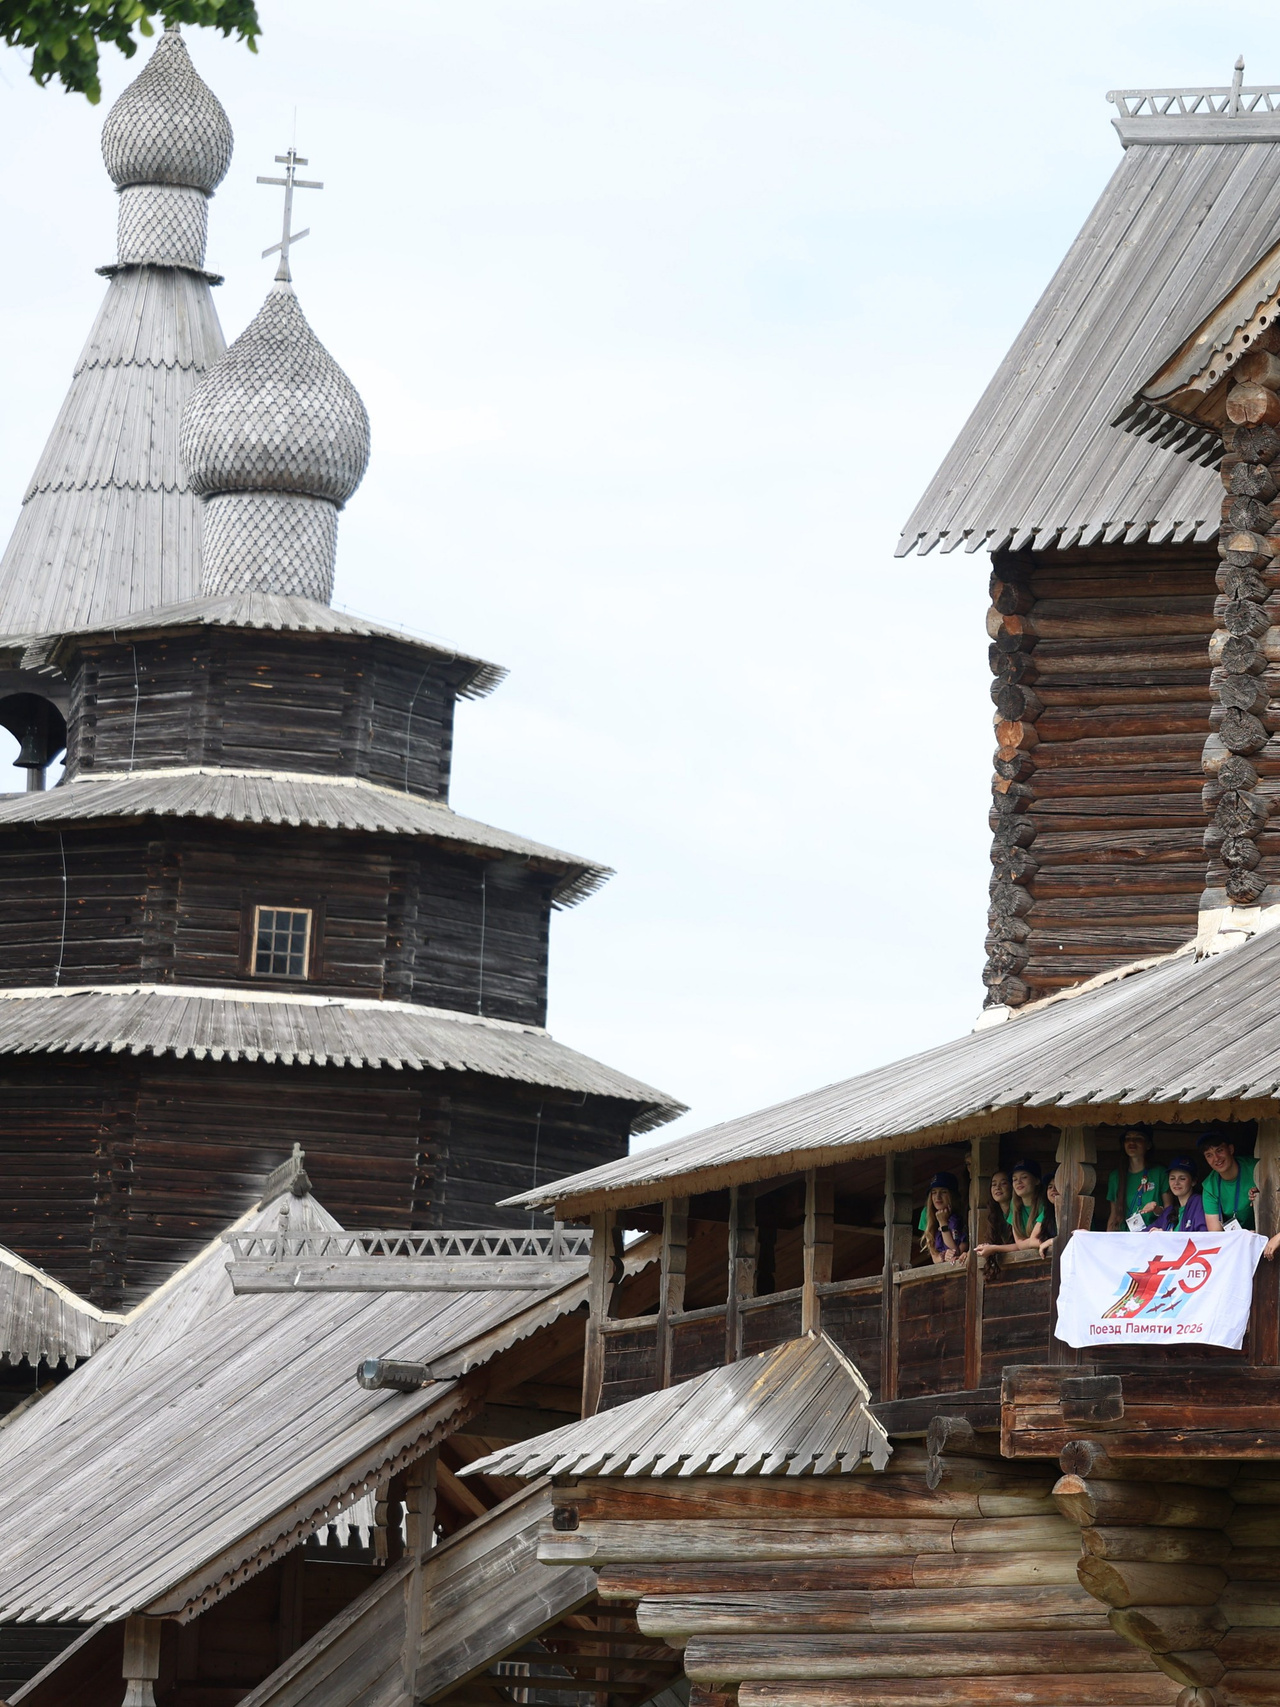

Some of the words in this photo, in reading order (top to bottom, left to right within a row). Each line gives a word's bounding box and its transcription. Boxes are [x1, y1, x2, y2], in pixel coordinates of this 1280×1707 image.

[1187, 1269, 1207, 1279] ЛЕТ
[1089, 1324, 1122, 1336] Поезд
[1125, 1322, 1173, 1335] Памяти
[1176, 1322, 1204, 1335] 2026
